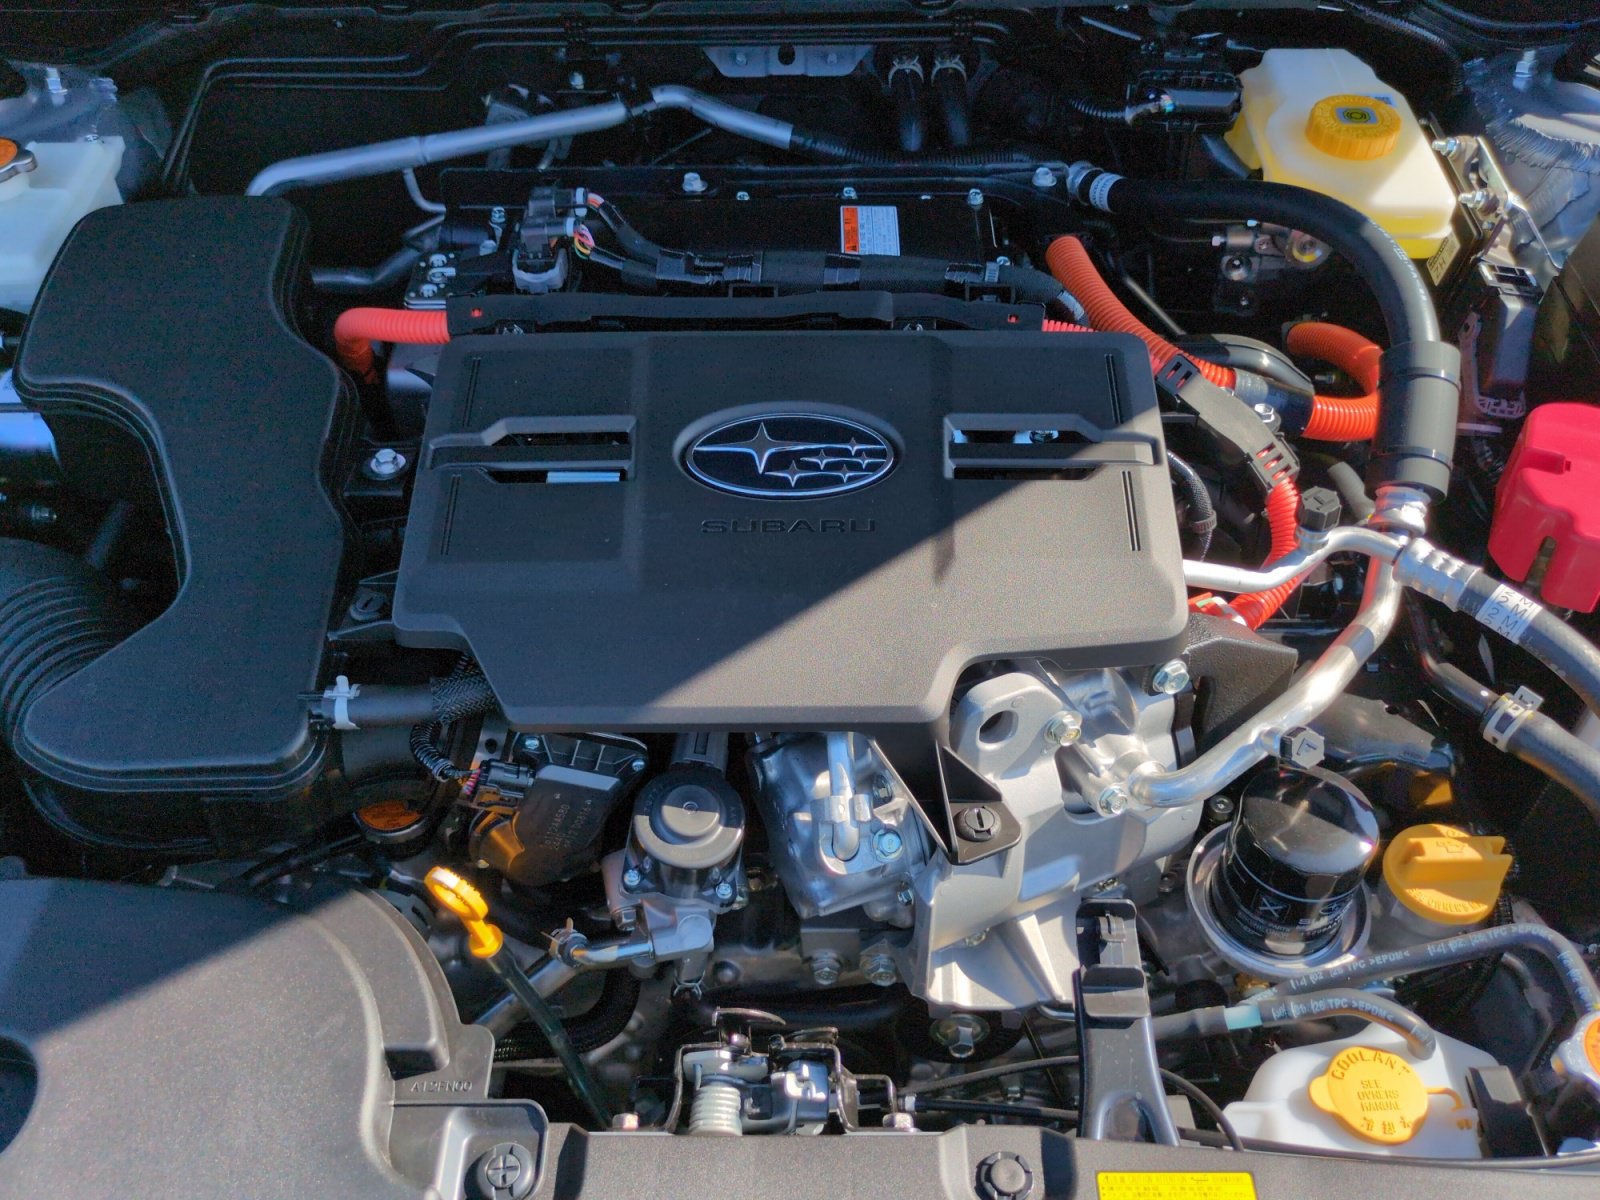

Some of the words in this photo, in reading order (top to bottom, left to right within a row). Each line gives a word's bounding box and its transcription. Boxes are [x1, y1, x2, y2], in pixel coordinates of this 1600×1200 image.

[701, 518, 876, 534] SUBARU
[1328, 998, 1348, 1010] TPC
[1351, 999, 1395, 1022] >EPDM<
[1331, 1050, 1411, 1081] COOLANT
